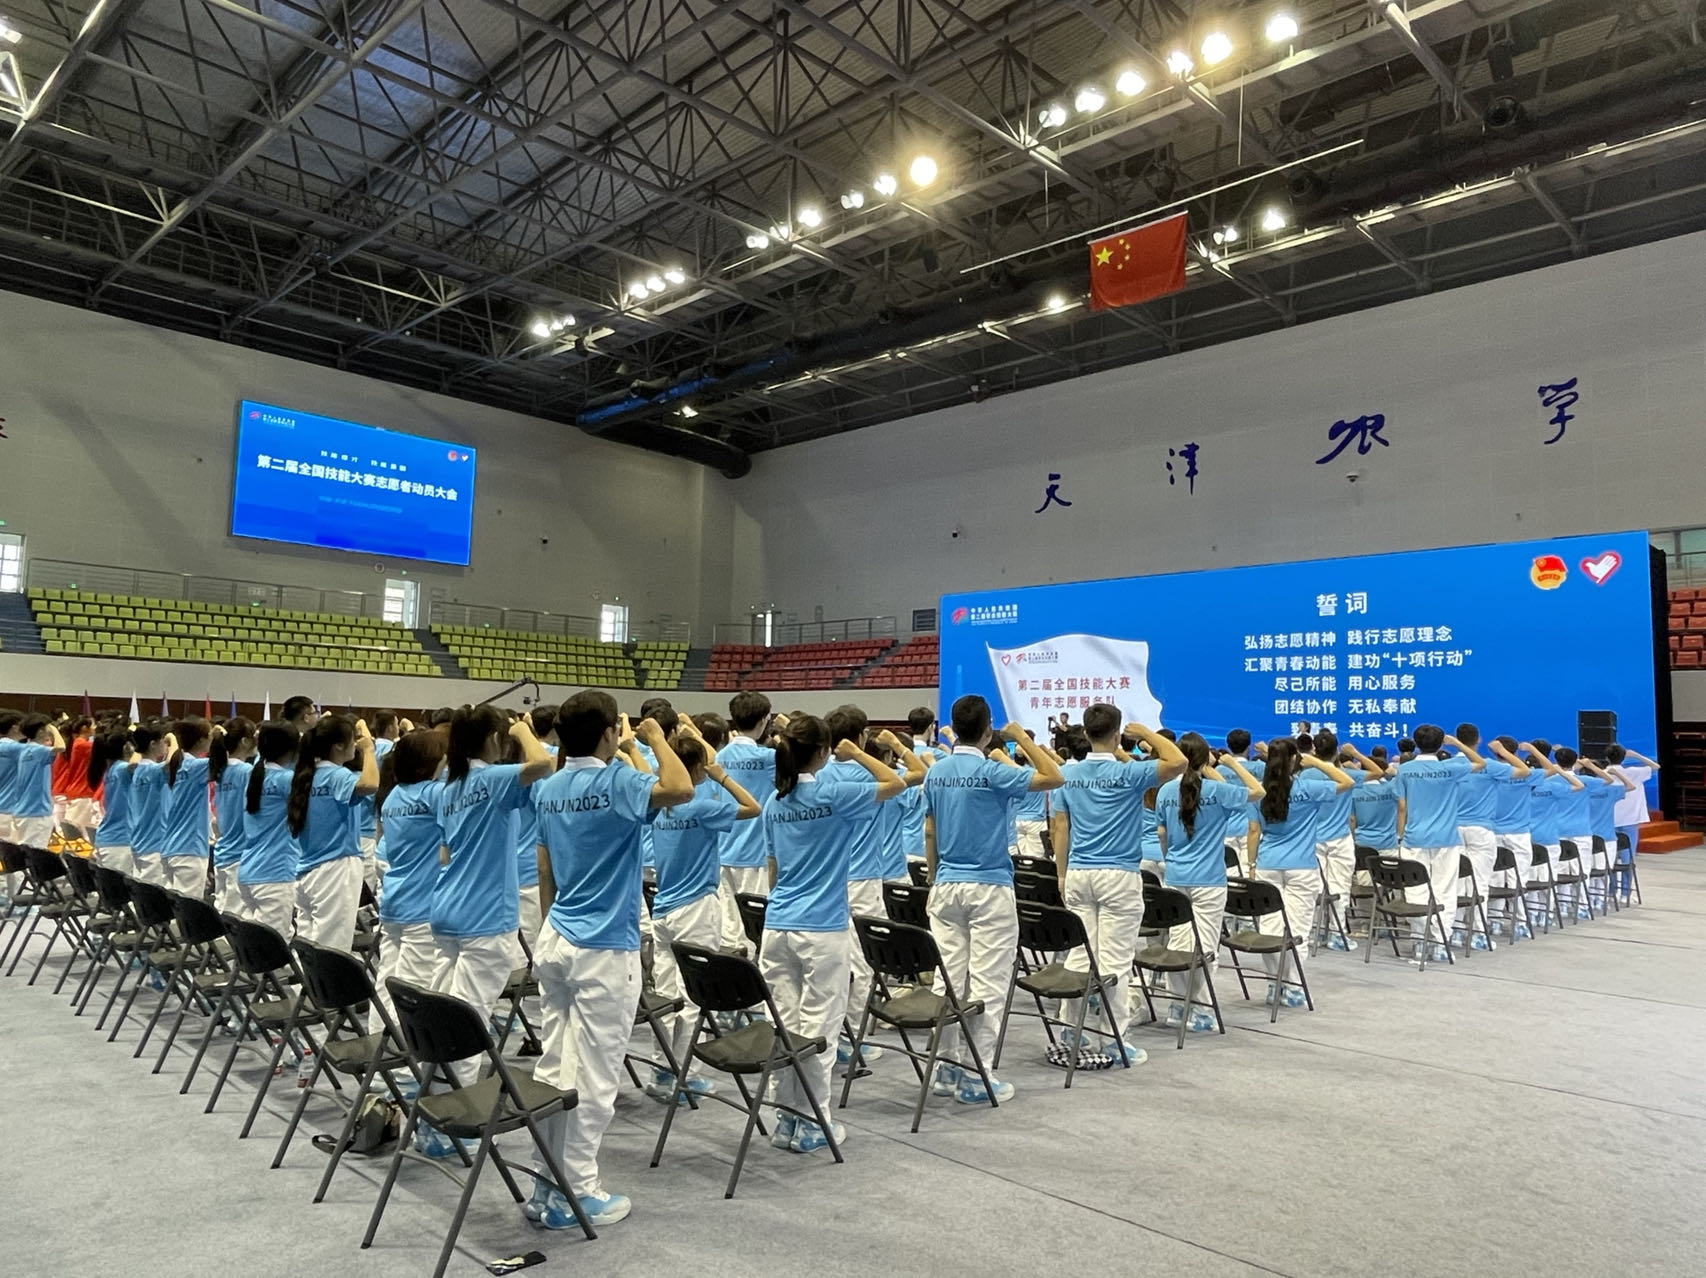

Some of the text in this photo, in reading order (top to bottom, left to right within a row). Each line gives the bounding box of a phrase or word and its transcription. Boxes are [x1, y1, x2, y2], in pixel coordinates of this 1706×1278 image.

[256, 454, 459, 501] 第二届全国技能大赛志愿者动员大会
[1316, 592, 1369, 616] 誓词
[1244, 626, 1453, 648] 弘扬志愿精神 践行志愿理念
[1244, 652, 1337, 672] 汇聚青春动能
[1018, 676, 1131, 691] 第二届全国技能大赛
[1273, 671, 1416, 692] 尽己所能 用心服务
[1273, 694, 1417, 714] 团结协作 无私奉献
